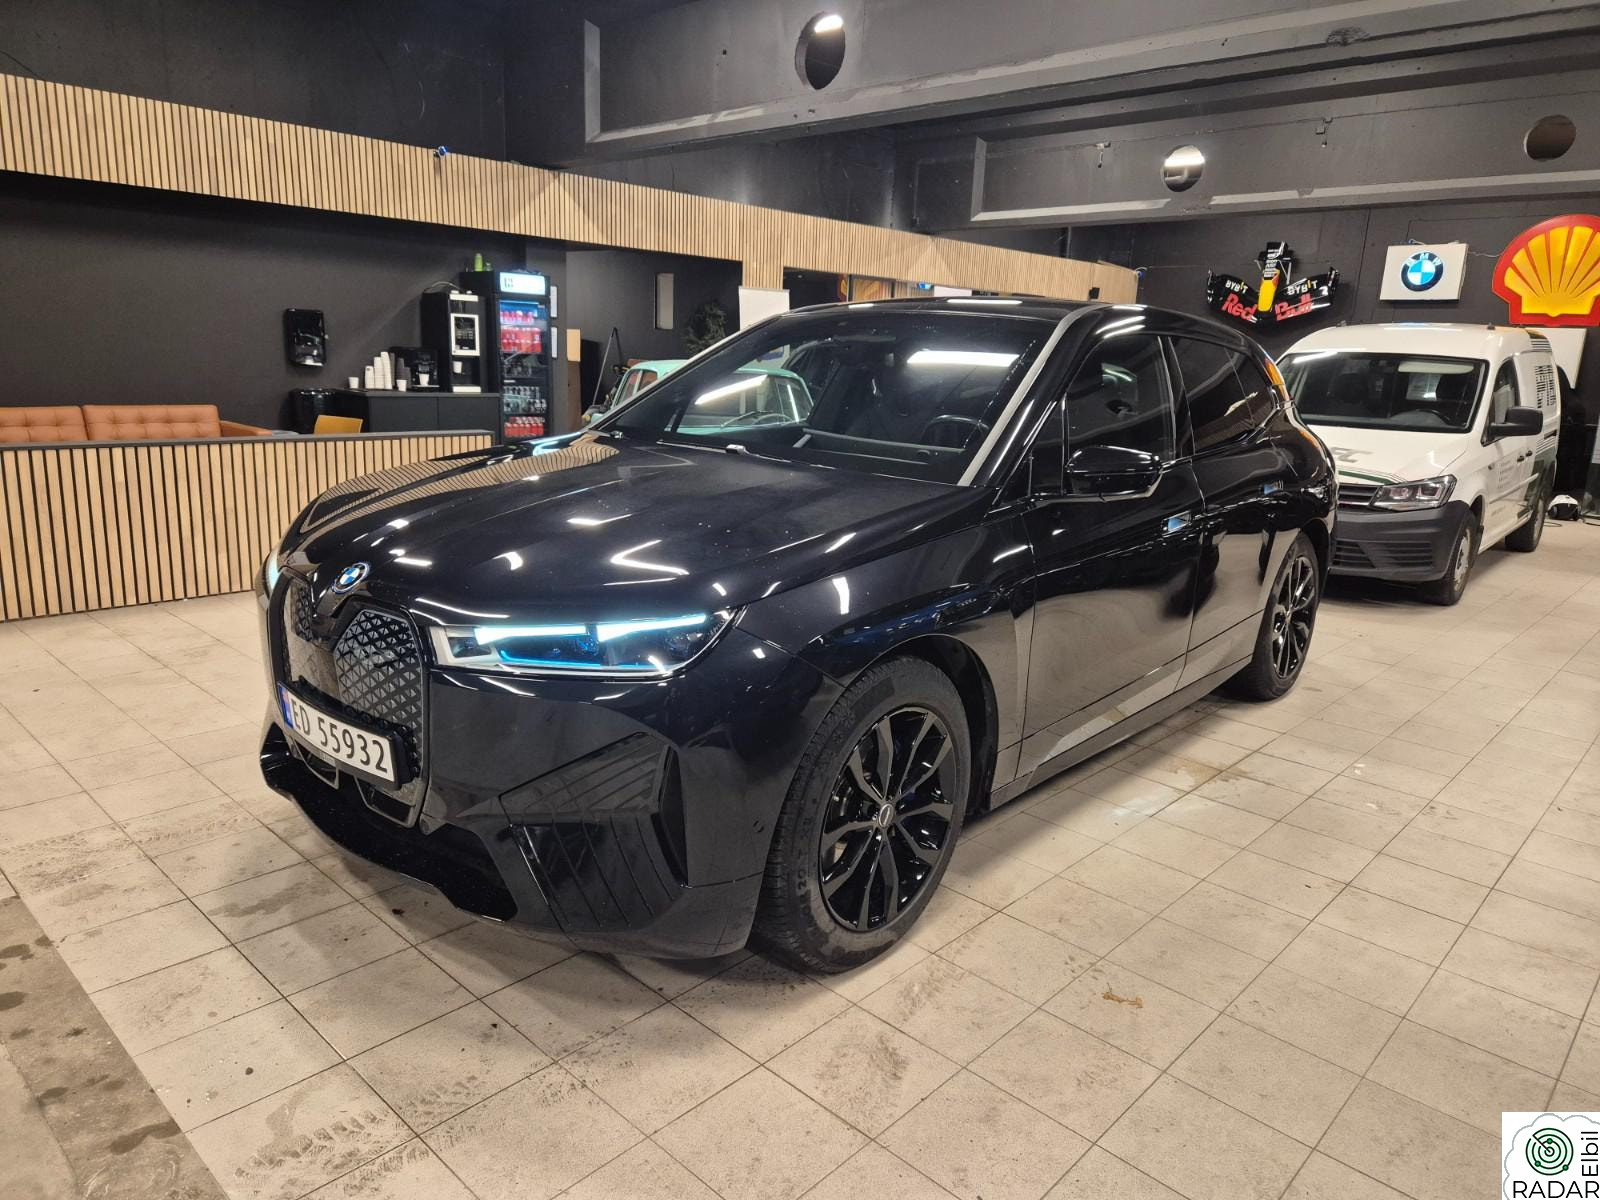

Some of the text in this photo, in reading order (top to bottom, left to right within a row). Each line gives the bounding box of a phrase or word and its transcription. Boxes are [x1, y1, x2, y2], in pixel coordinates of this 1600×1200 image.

[1225, 280, 1249, 294] BYBIT
[1286, 279, 1318, 296] BYBIT
[1221, 292, 1259, 321] Red
[291, 698, 388, 774] ED 55932
